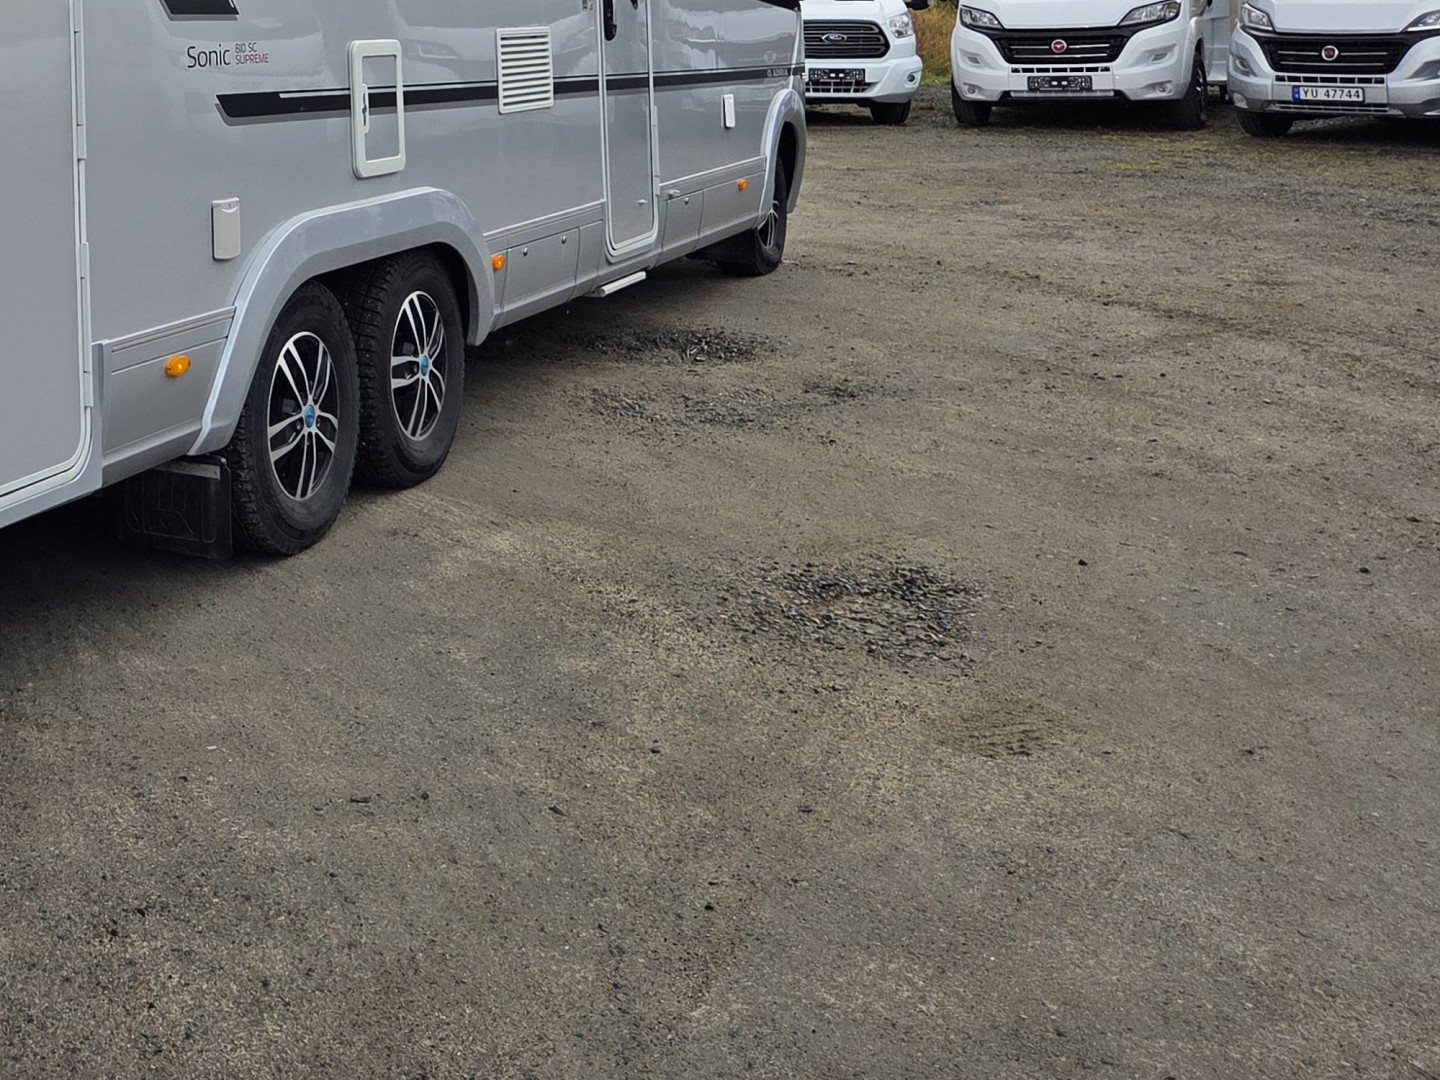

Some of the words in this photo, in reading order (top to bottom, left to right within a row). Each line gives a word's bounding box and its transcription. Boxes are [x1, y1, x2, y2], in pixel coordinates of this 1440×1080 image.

[186, 43, 231, 69] Sonic
[248, 42, 258, 53] SC
[234, 53, 270, 65] SUPREME
[1302, 88, 1319, 98] YU
[1323, 89, 1361, 99] 47744
